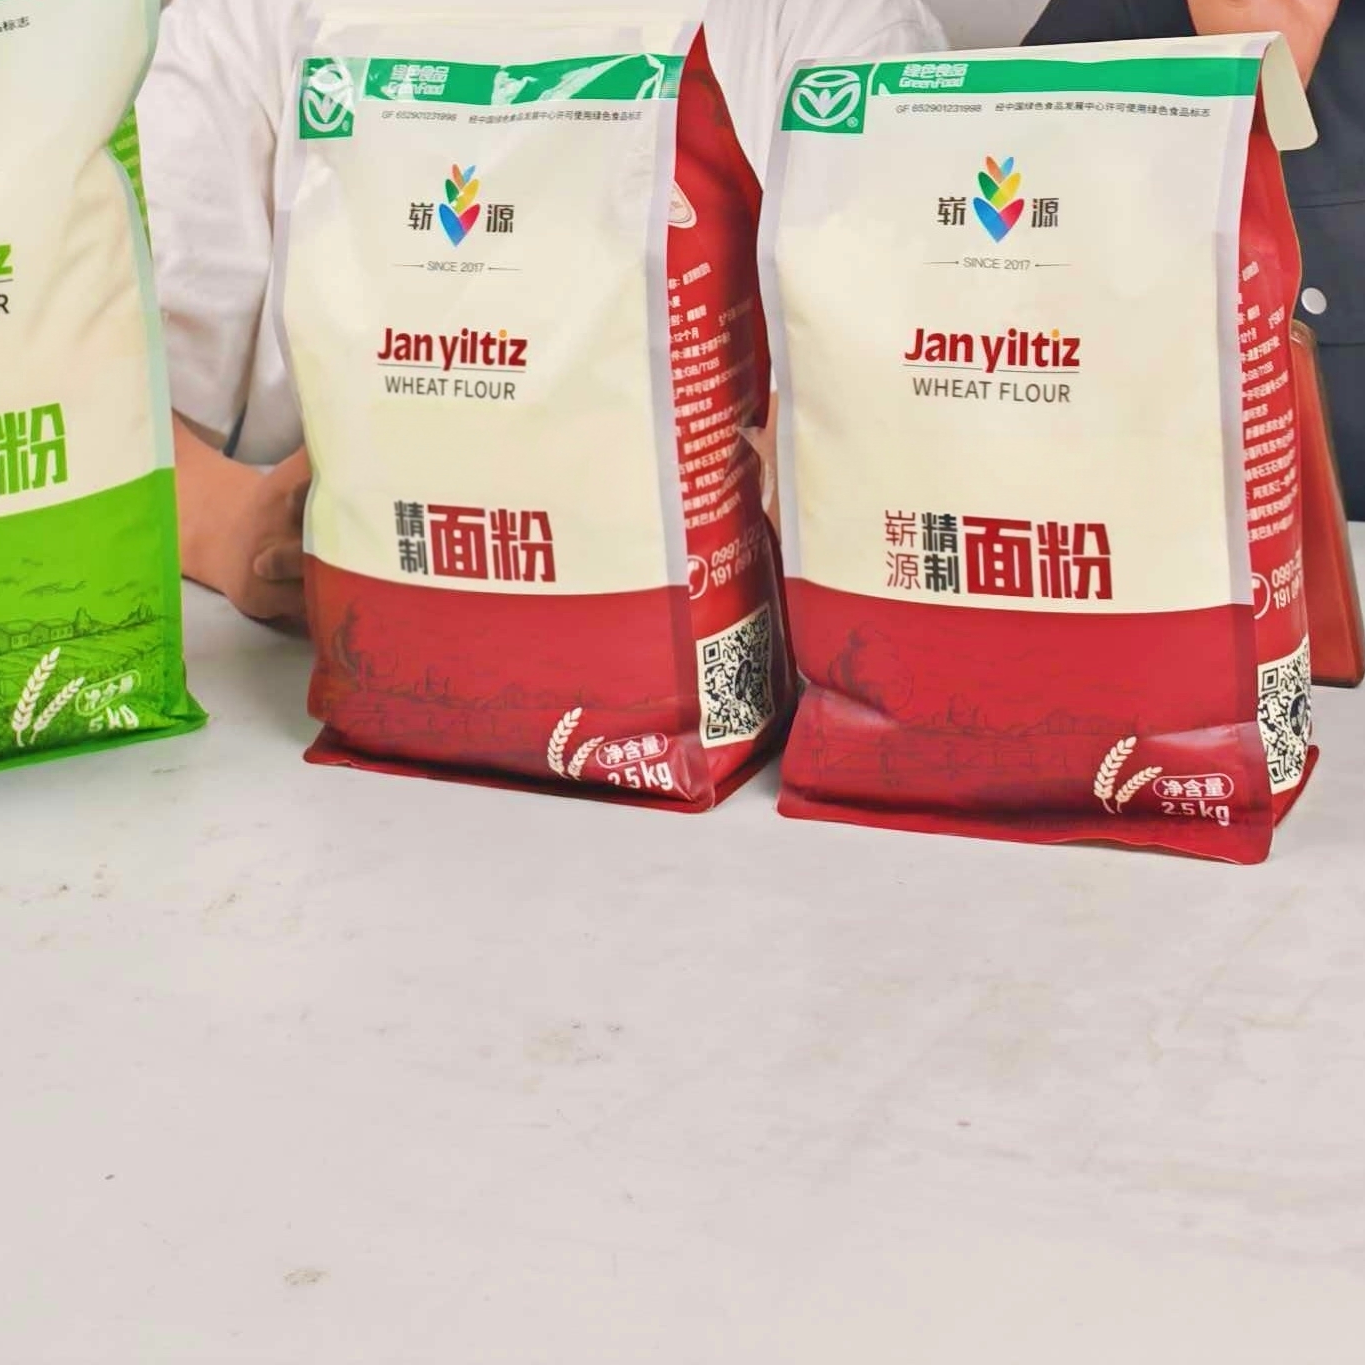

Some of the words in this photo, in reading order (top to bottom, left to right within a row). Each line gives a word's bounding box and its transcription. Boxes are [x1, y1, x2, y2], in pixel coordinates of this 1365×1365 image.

[486, 204, 515, 233] 源
[1031, 197, 1059, 228] 源
[426, 260, 458, 272] SINCE
[460, 262, 486, 273] 2017
[963, 256, 1002, 269] SINCE
[1004, 259, 1031, 270] 2017
[385, 375, 449, 396] WHEAT
[454, 379, 516, 400] FLOUR
[912, 377, 992, 400] WHEAT
[999, 382, 1071, 403] FLOUR
[393, 500, 428, 576] 精制
[427, 504, 556, 583] 面粉
[921, 512, 960, 594] 精制
[962, 516, 1113, 600] 面粉
[603, 734, 663, 765] 净含量
